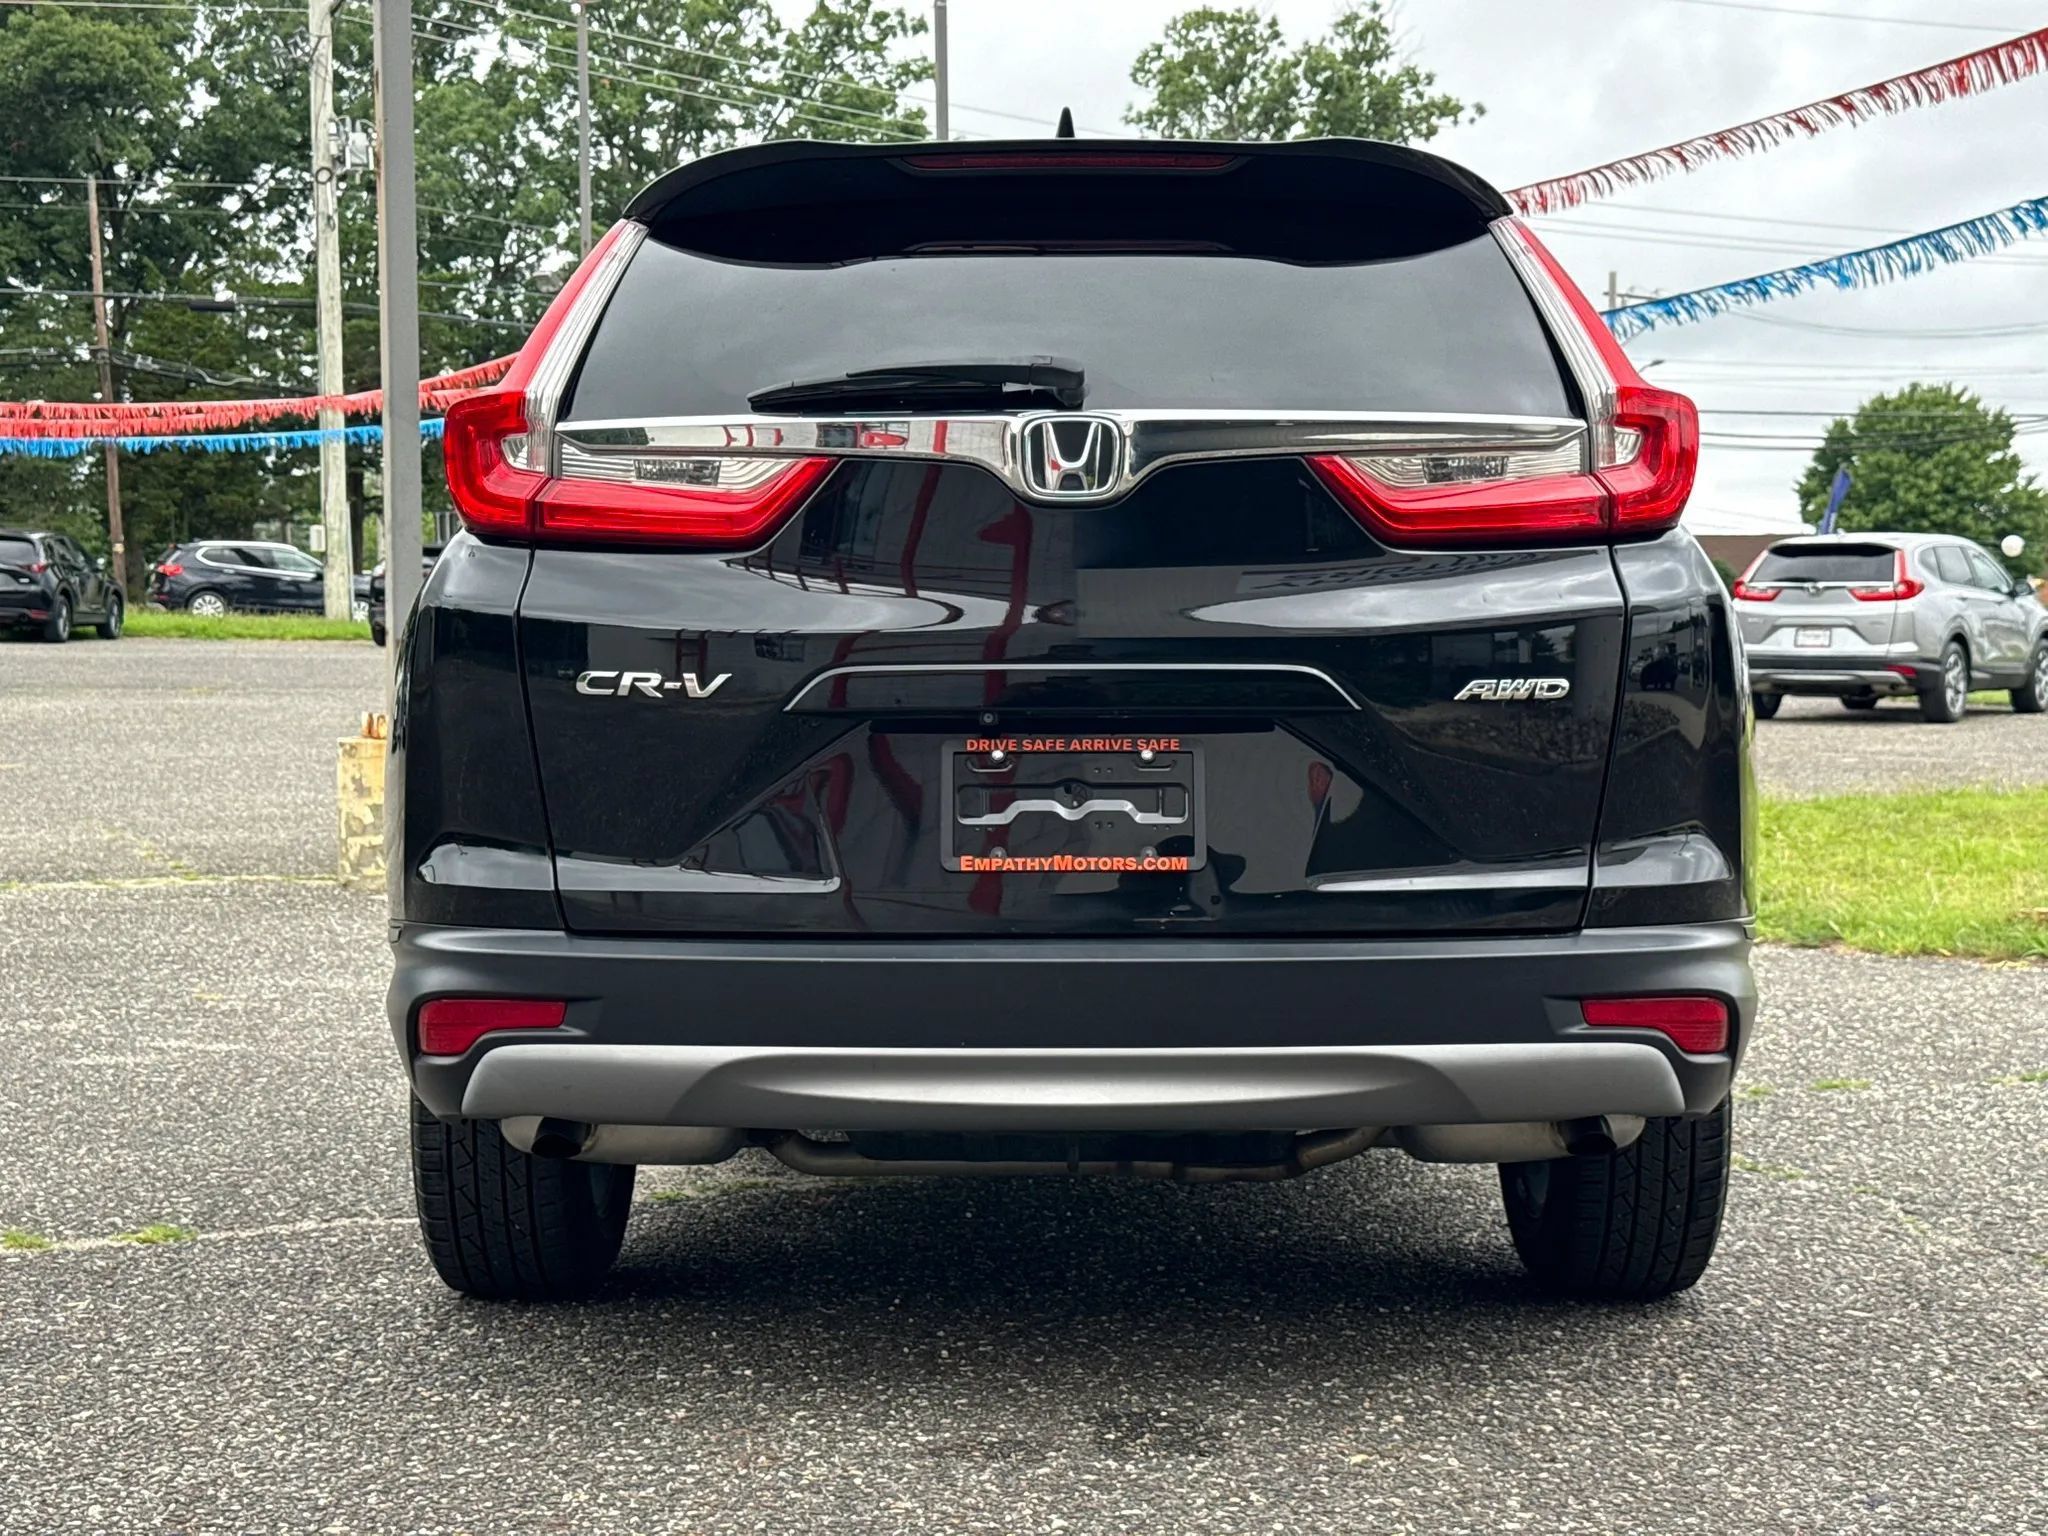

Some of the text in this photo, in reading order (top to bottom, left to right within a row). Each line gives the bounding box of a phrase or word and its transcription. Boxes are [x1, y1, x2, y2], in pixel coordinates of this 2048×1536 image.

[575, 670, 733, 699] CR-V
[1453, 677, 1571, 701] AWD
[966, 738, 1181, 752] DRIVE SAFE ARRIVE SAFE
